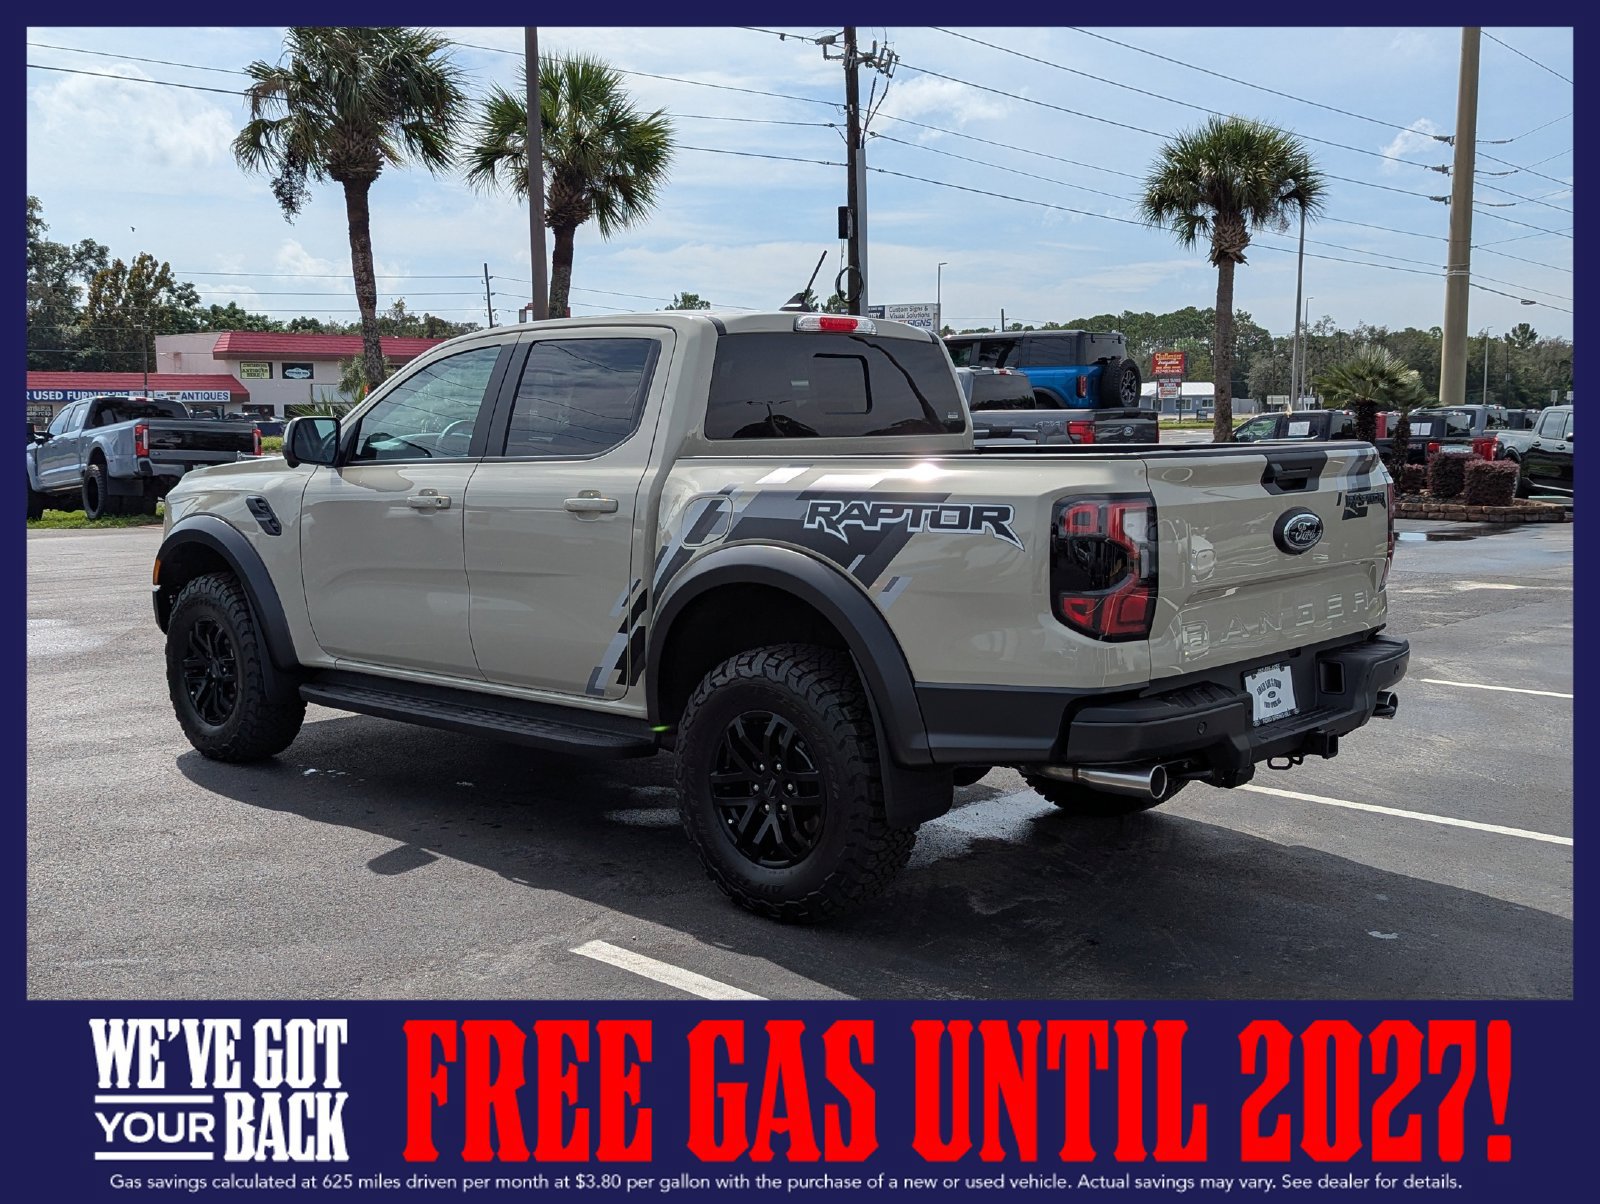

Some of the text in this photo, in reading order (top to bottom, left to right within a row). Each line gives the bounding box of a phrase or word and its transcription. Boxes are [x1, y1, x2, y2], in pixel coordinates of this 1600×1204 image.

[33, 391, 64, 400] USED
[181, 392, 229, 400] ANTIQUES
[803, 500, 1025, 552] RAPTOR
[1181, 591, 1374, 653] RANGER
